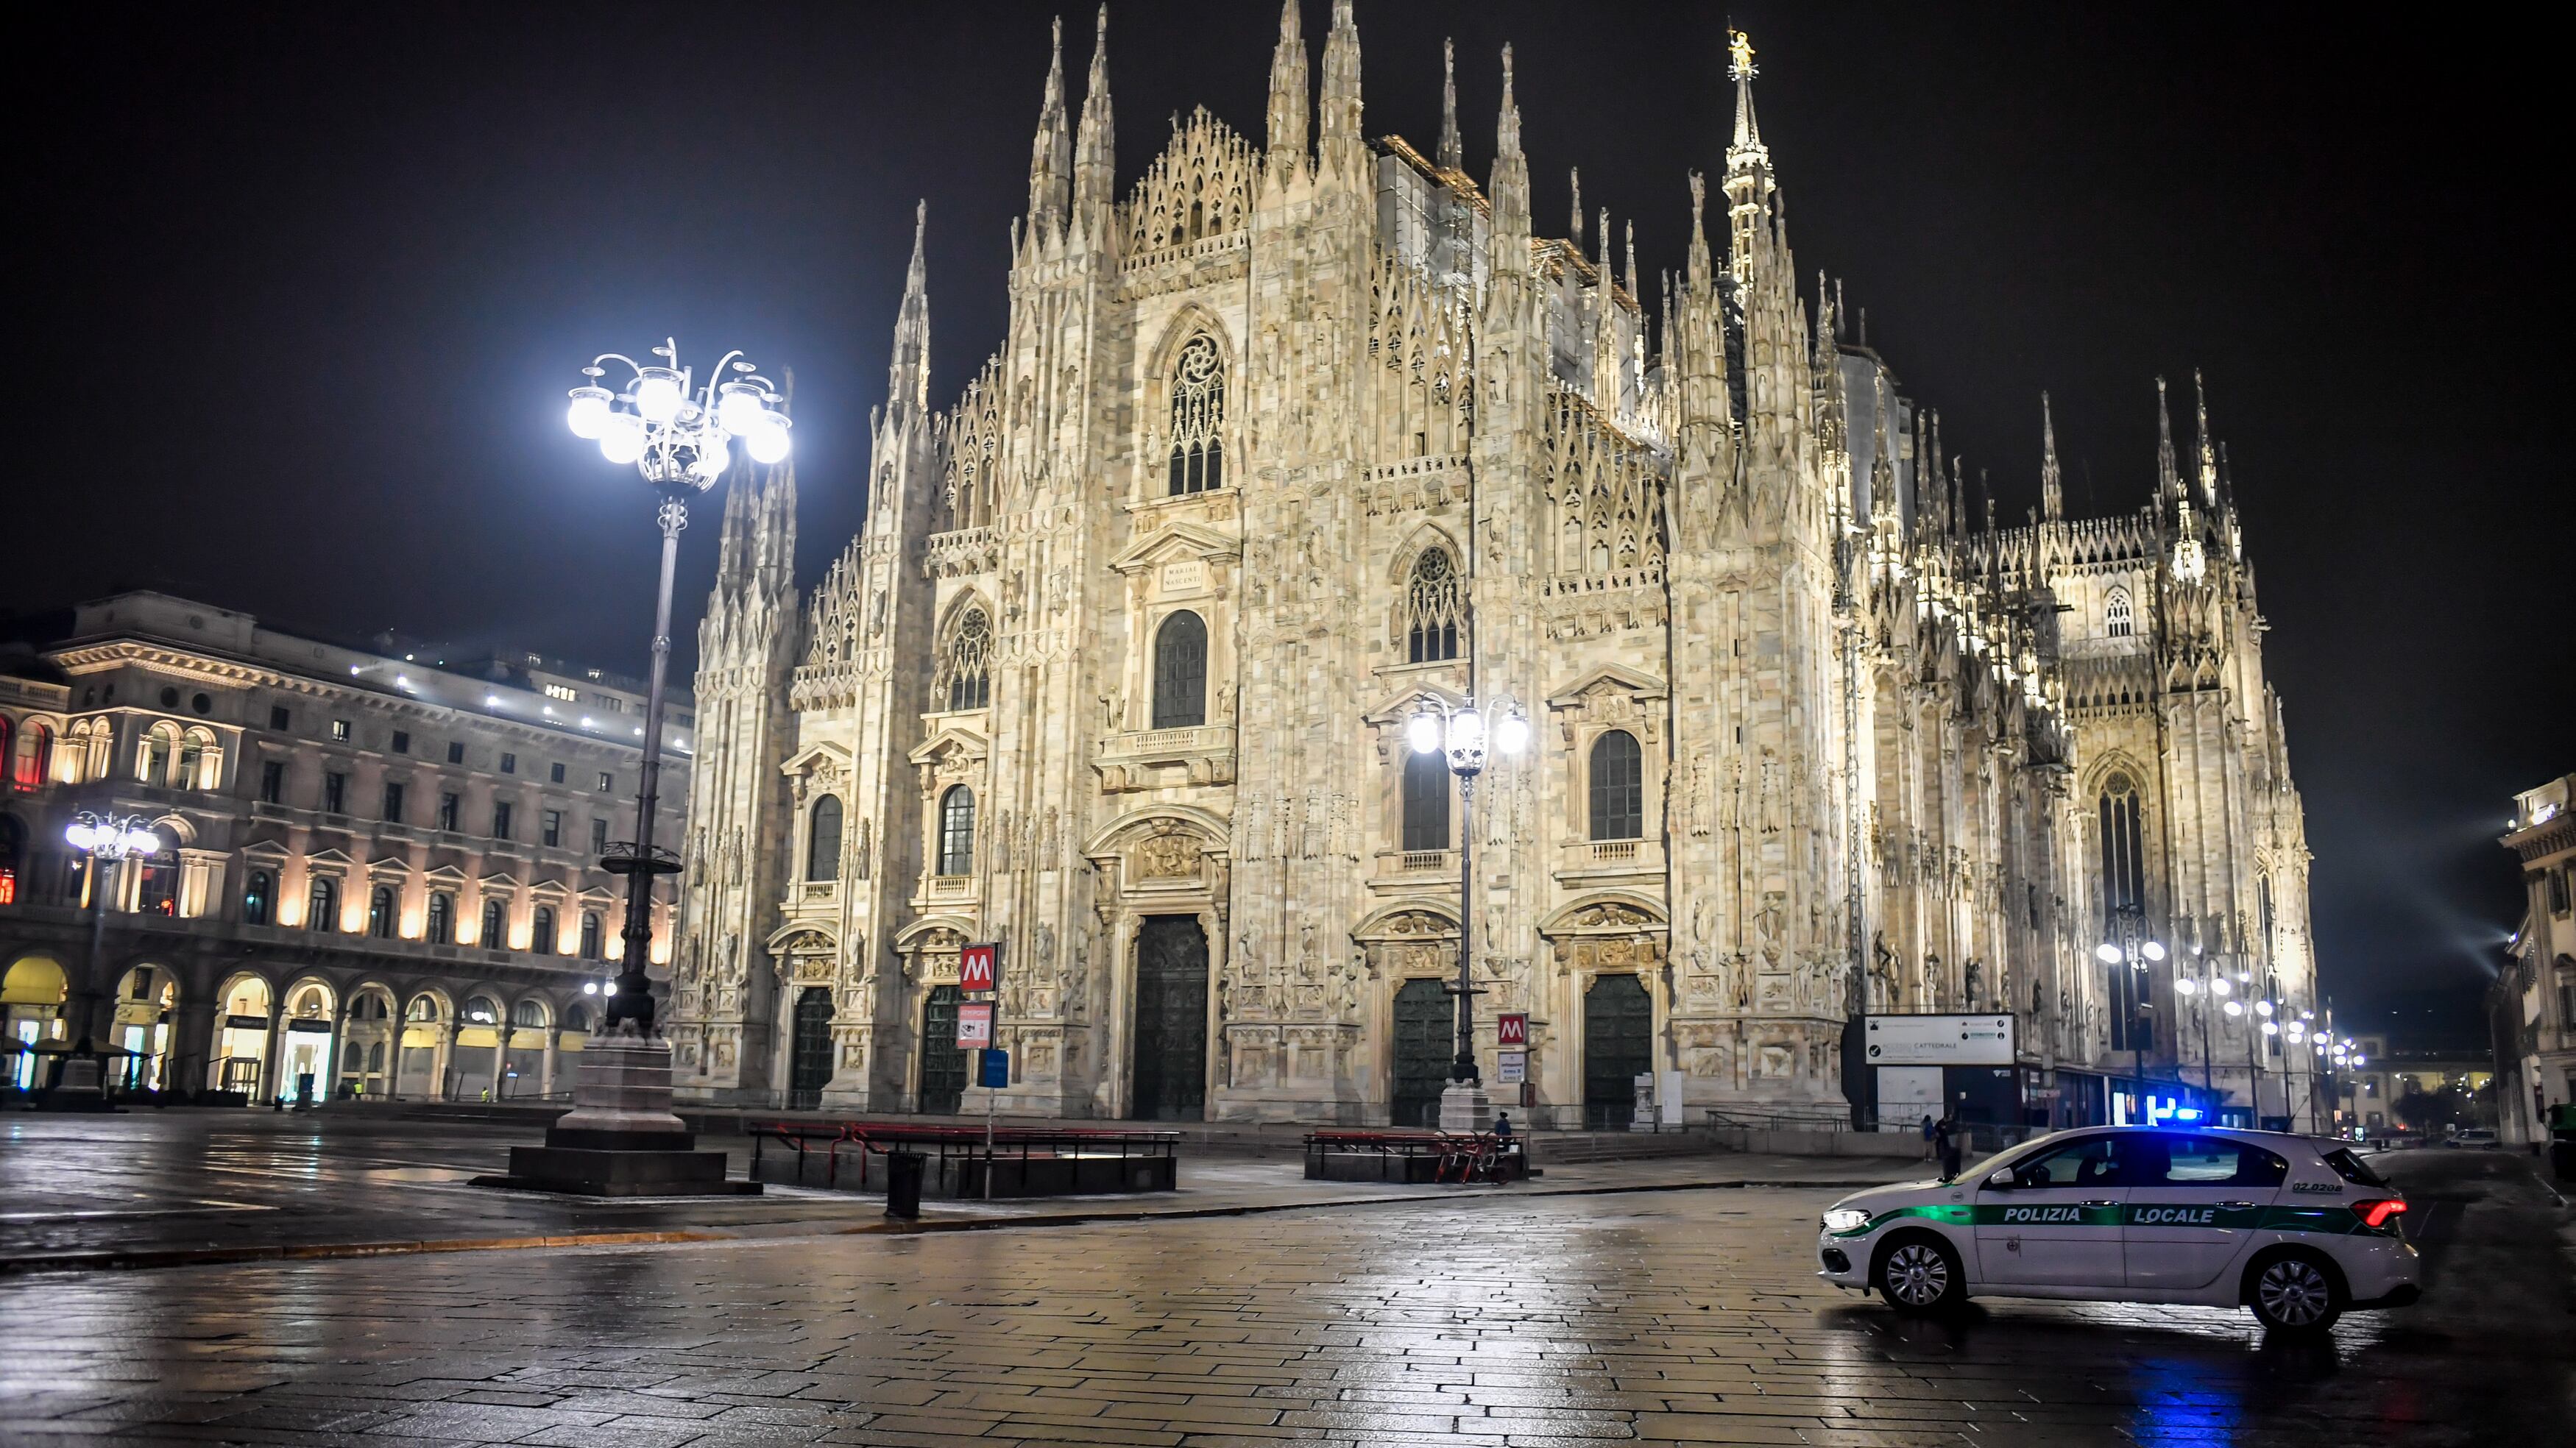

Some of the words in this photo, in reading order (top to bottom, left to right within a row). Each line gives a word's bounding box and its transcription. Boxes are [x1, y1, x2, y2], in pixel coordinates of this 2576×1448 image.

[963, 954, 991, 981] M
[1501, 1021, 1522, 1038] M
[2003, 1207, 2081, 1222] POLIZIA
[2134, 1209, 2215, 1224] LOCALE
